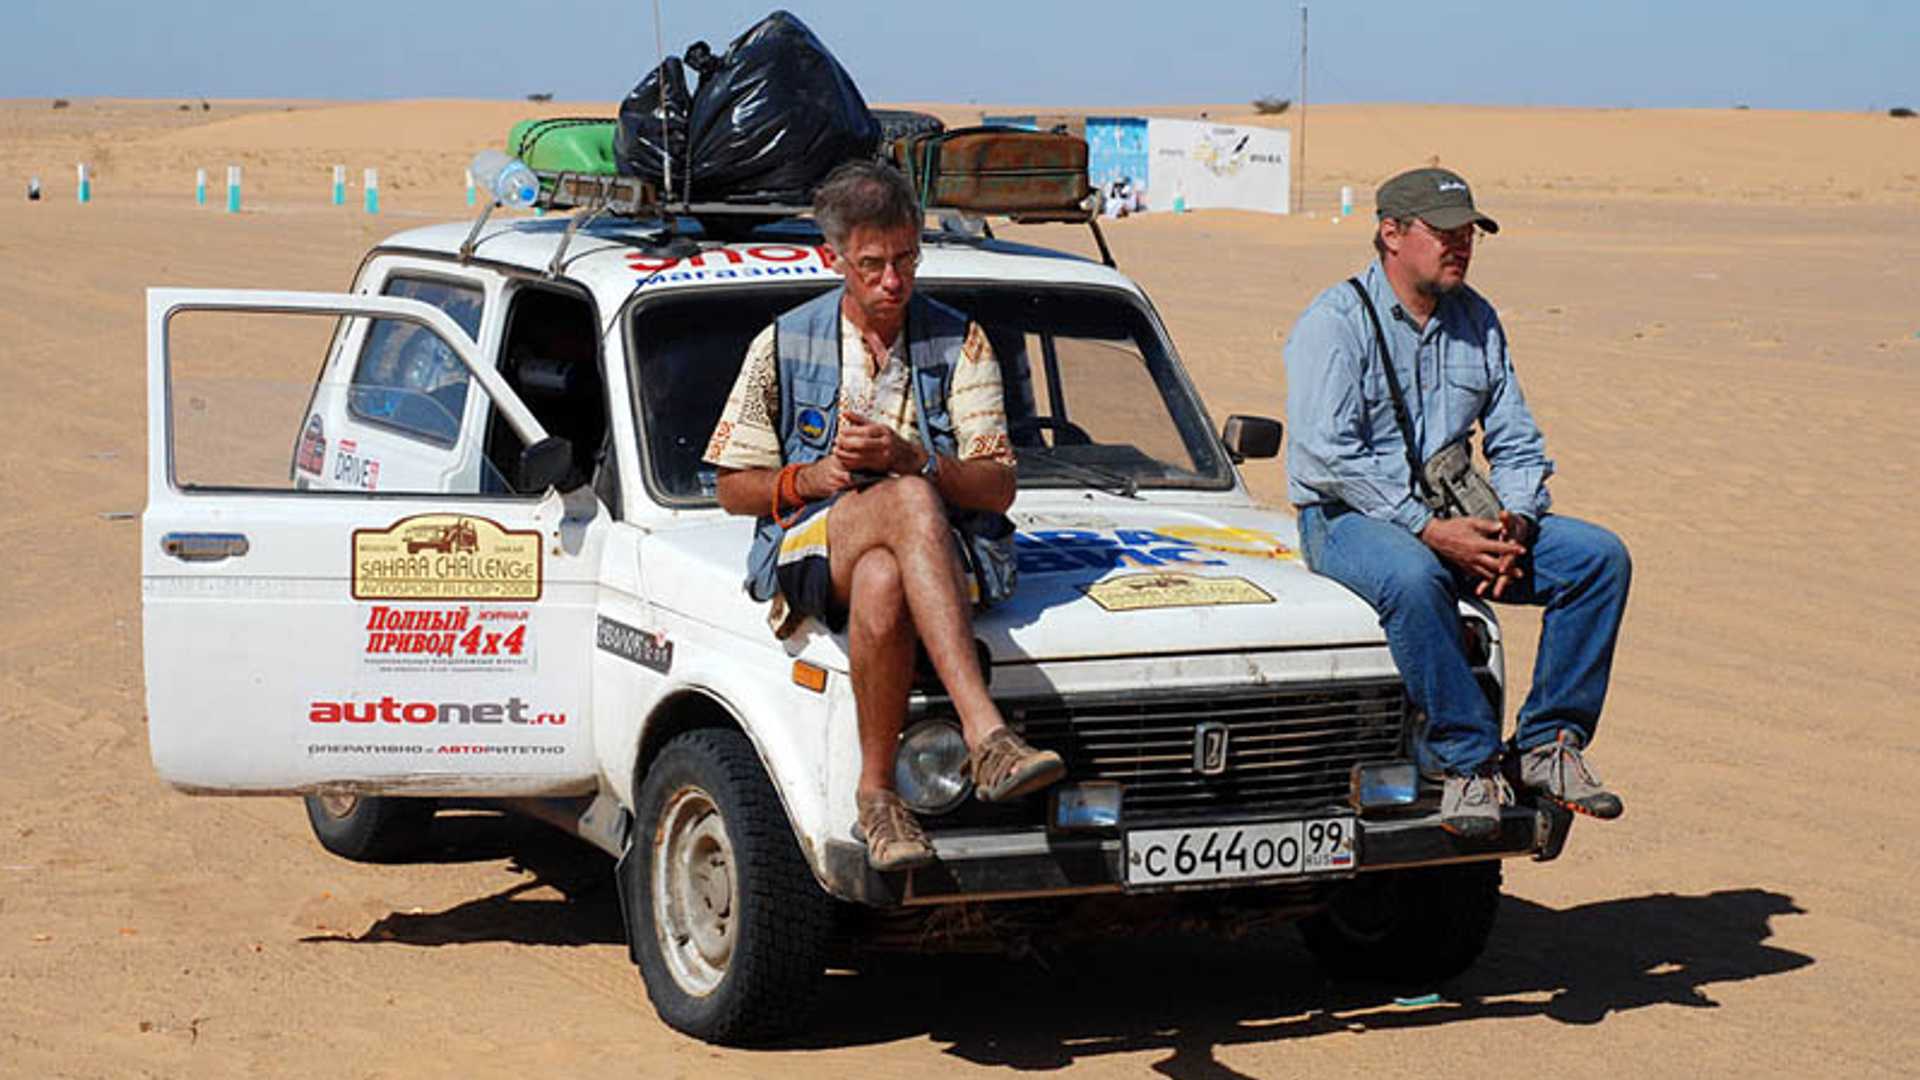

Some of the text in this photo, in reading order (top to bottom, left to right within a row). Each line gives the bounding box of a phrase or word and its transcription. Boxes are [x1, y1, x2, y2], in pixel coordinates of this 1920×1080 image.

[360, 556, 430, 578] SAHARA
[308, 697, 566, 724] autonet.ru
[437, 745, 566, 754] АВТОРИТЕТНО
[1308, 822, 1343, 853] 99
[1307, 855, 1331, 866] RUS
